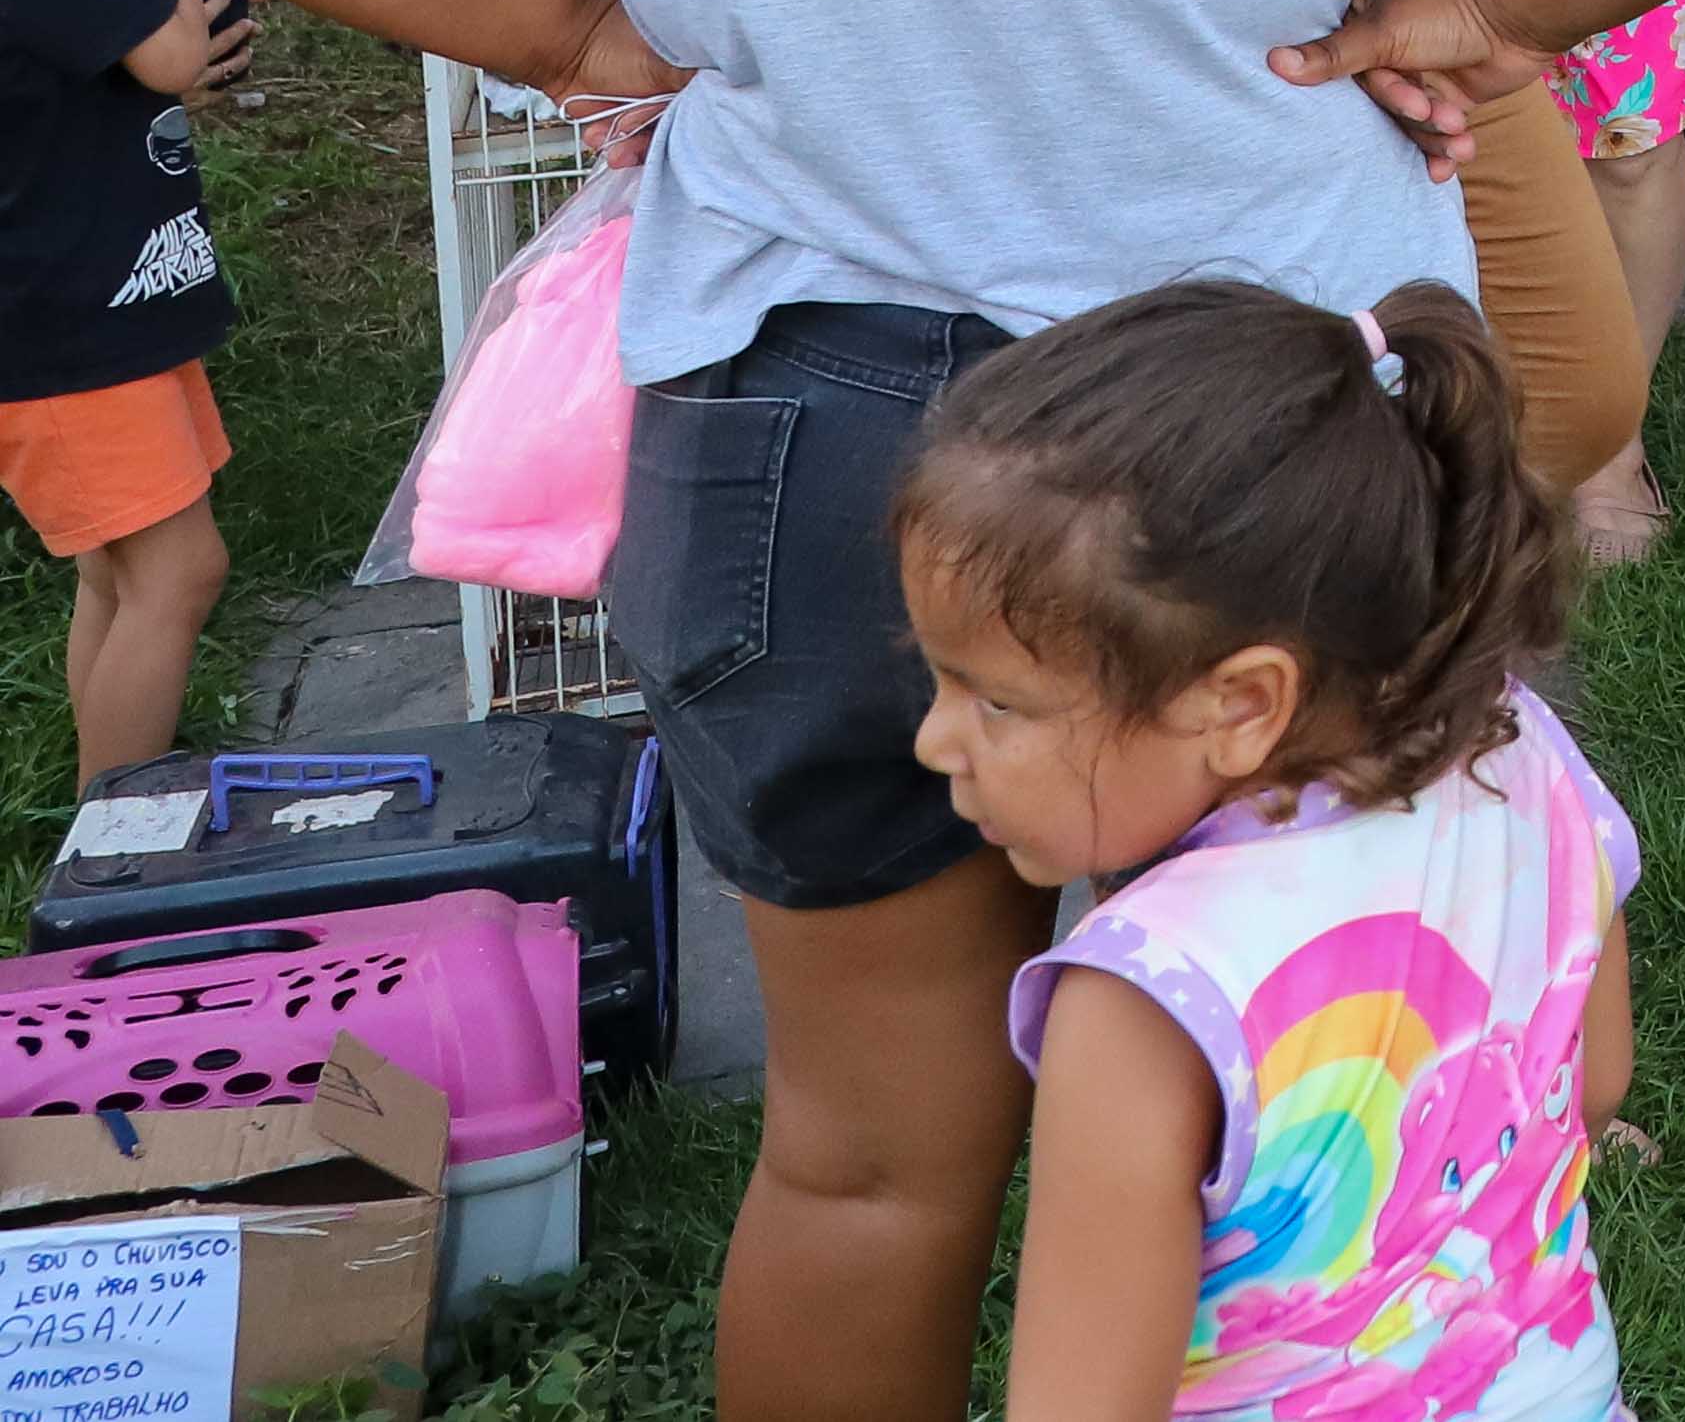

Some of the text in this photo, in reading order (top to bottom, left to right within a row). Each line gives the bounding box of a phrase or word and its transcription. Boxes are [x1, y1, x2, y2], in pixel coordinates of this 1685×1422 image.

[133, 206, 206, 271] MILES
[27, 1250, 68, 1274] SOU
[82, 1249, 99, 1268] O
[15, 1268, 207, 1311] LEVA PRA SUA
[7, 1359, 145, 1392] AMOROSO
[53, 1391, 190, 1422] TRABALHO
